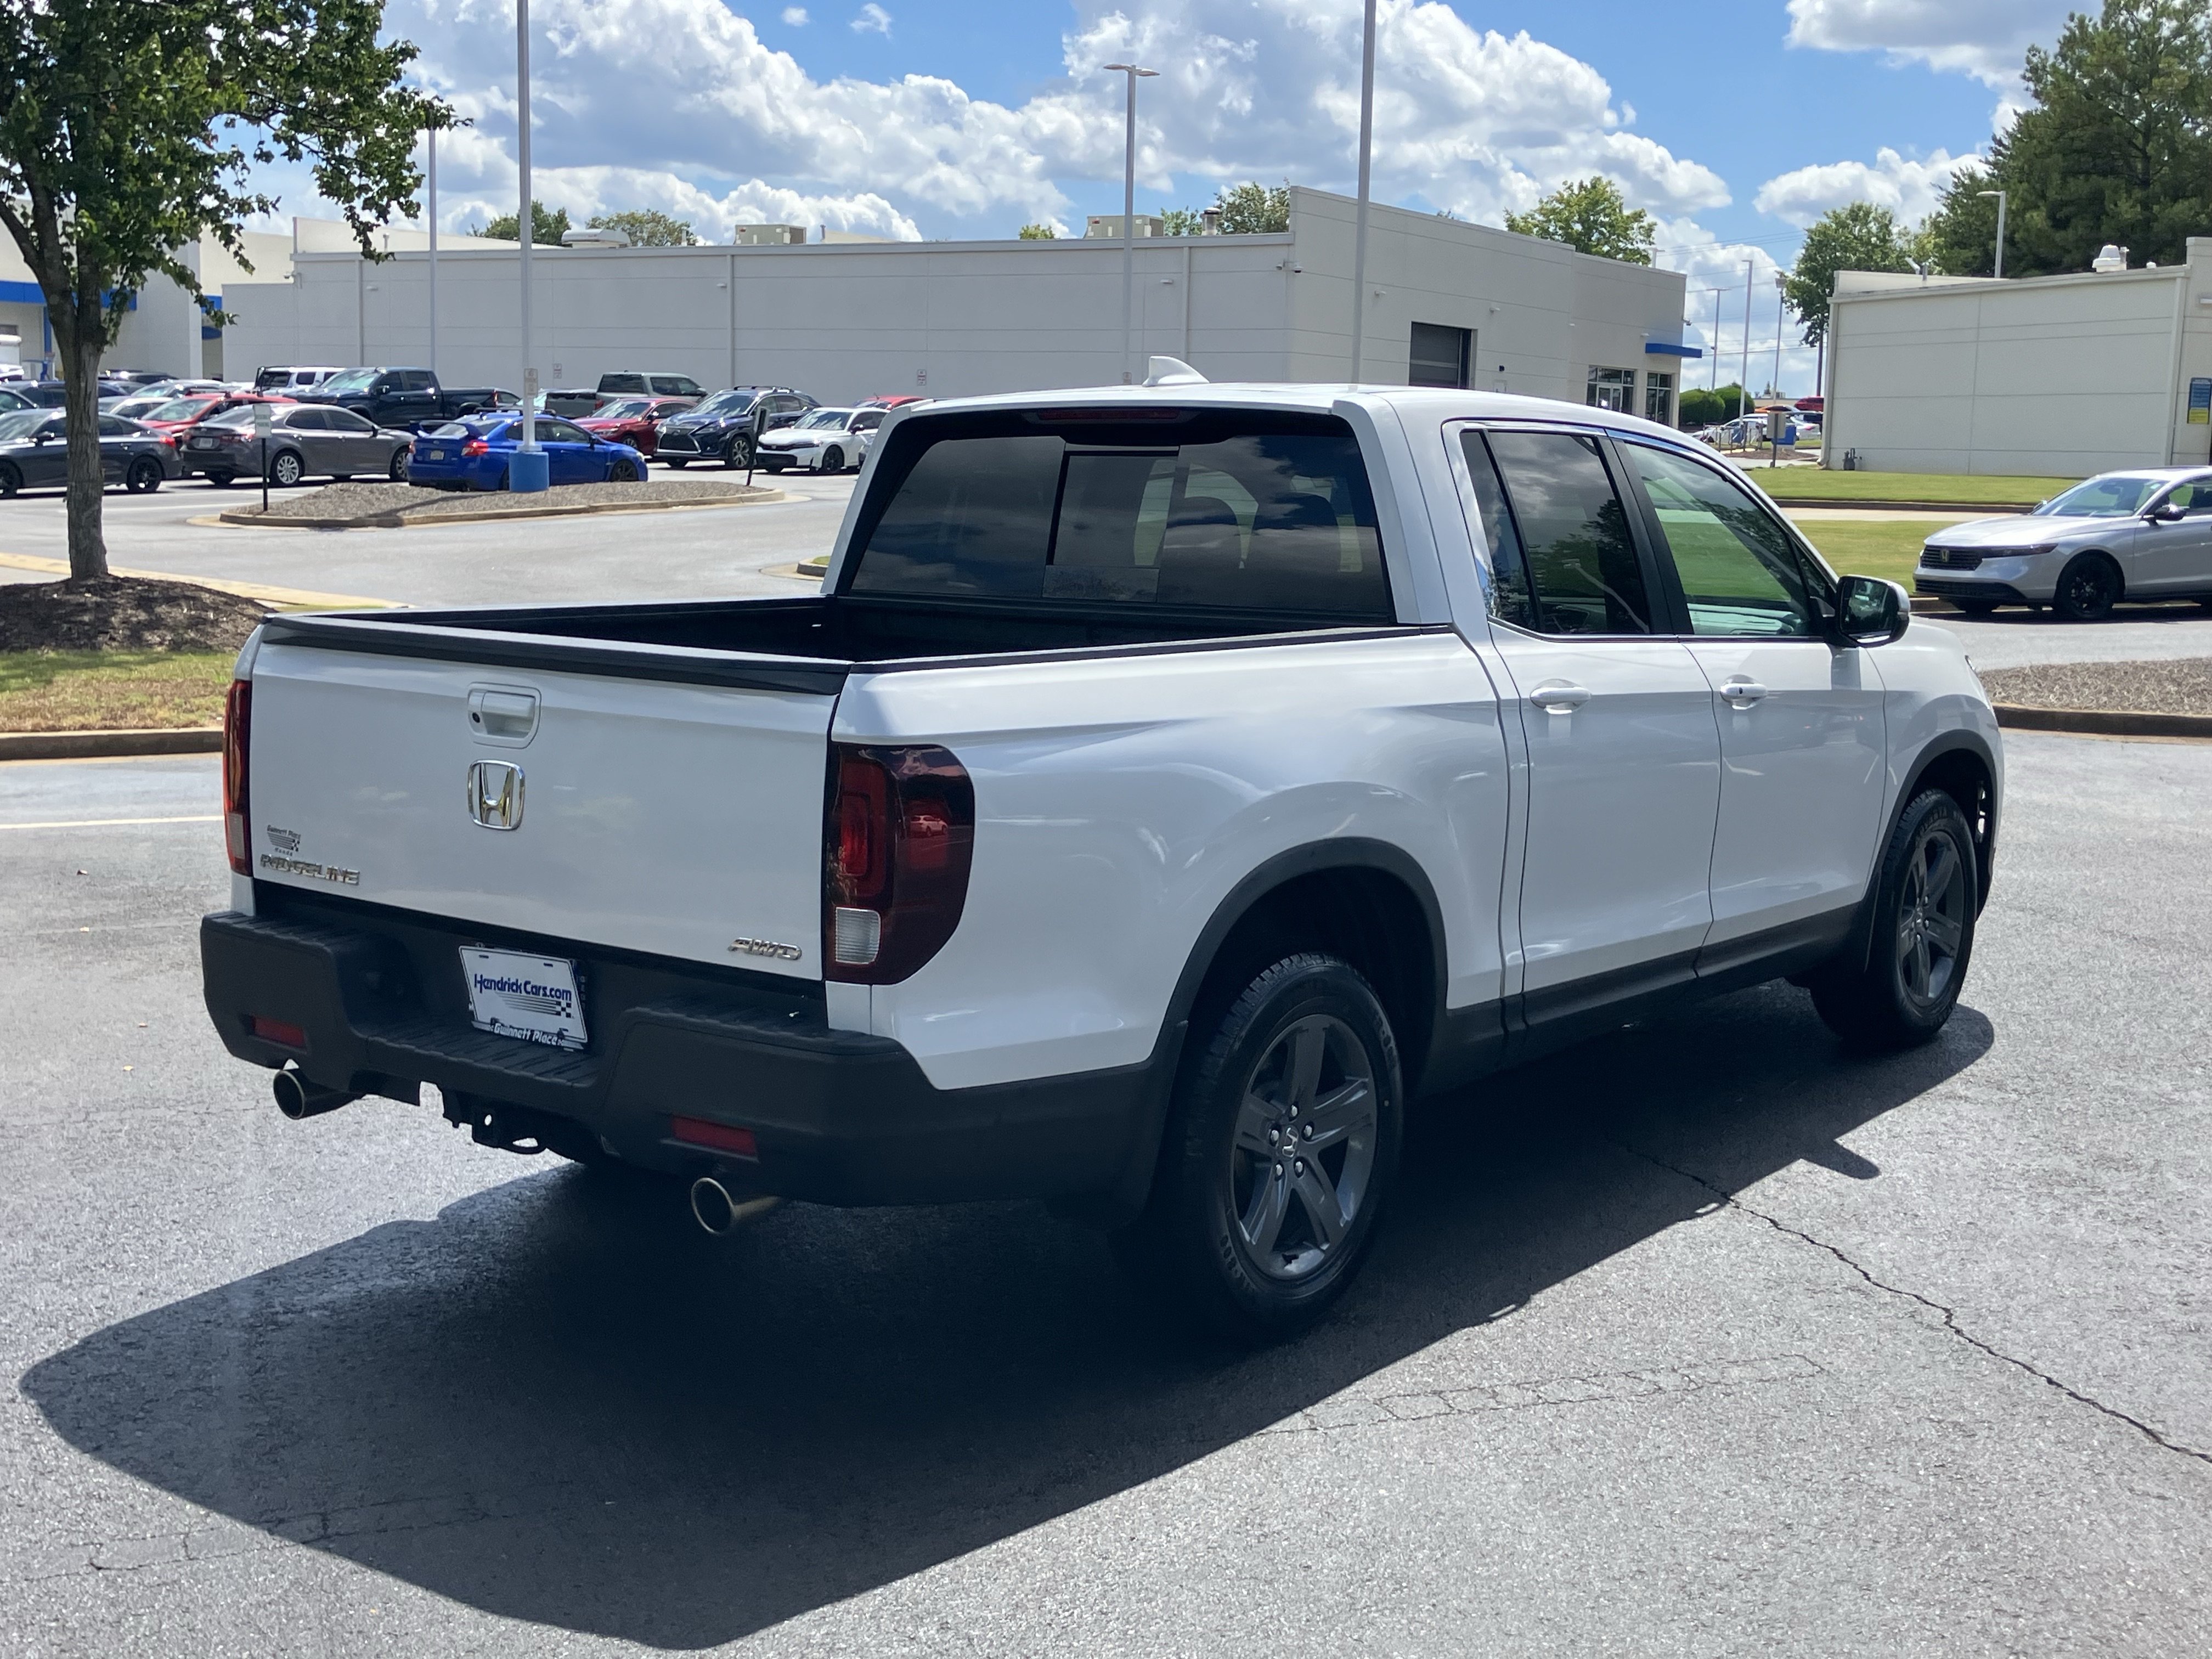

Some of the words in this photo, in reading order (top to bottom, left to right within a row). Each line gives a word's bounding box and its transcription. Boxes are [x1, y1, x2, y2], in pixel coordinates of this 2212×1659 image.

[727, 937, 802, 960] AWD
[494, 1023, 531, 1041] Gwinnett
[532, 1029, 558, 1045] Place
